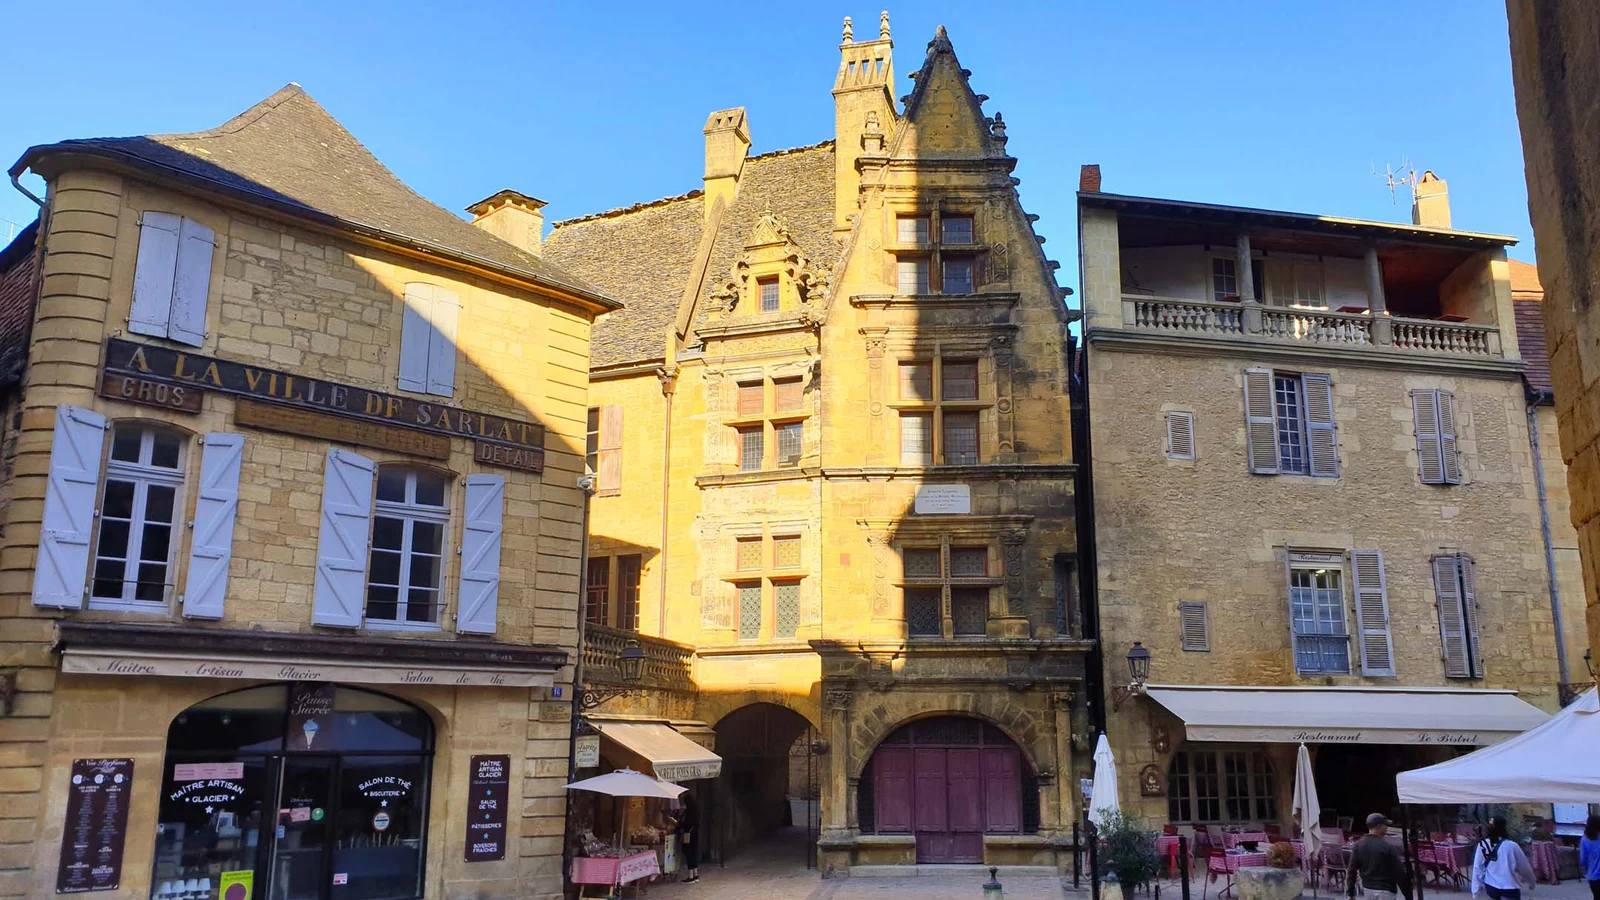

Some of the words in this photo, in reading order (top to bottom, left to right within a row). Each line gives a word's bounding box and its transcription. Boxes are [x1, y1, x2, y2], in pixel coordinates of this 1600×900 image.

[121, 377, 185, 406] GROS
[126, 346, 152, 373] A
[173, 354, 223, 387] LA
[244, 368, 348, 410] VILLE
[416, 404, 532, 444] SARLAT
[97, 658, 155, 674] Maître
[185, 662, 244, 677] Artisan
[277, 665, 321, 680] Glacier
[400, 671, 434, 683] Salon
[456, 673, 469, 684] de
[490, 673, 505, 685] thé
[1293, 731, 1362, 741] Restaurant
[1418, 733, 1432, 742] Le
[1436, 733, 1480, 743] Bistrot
[207, 780, 245, 794] ARTISAN
[358, 777, 383, 791] SALON
[384, 776, 396, 784] DE
[191, 794, 229, 803] GLACIER
